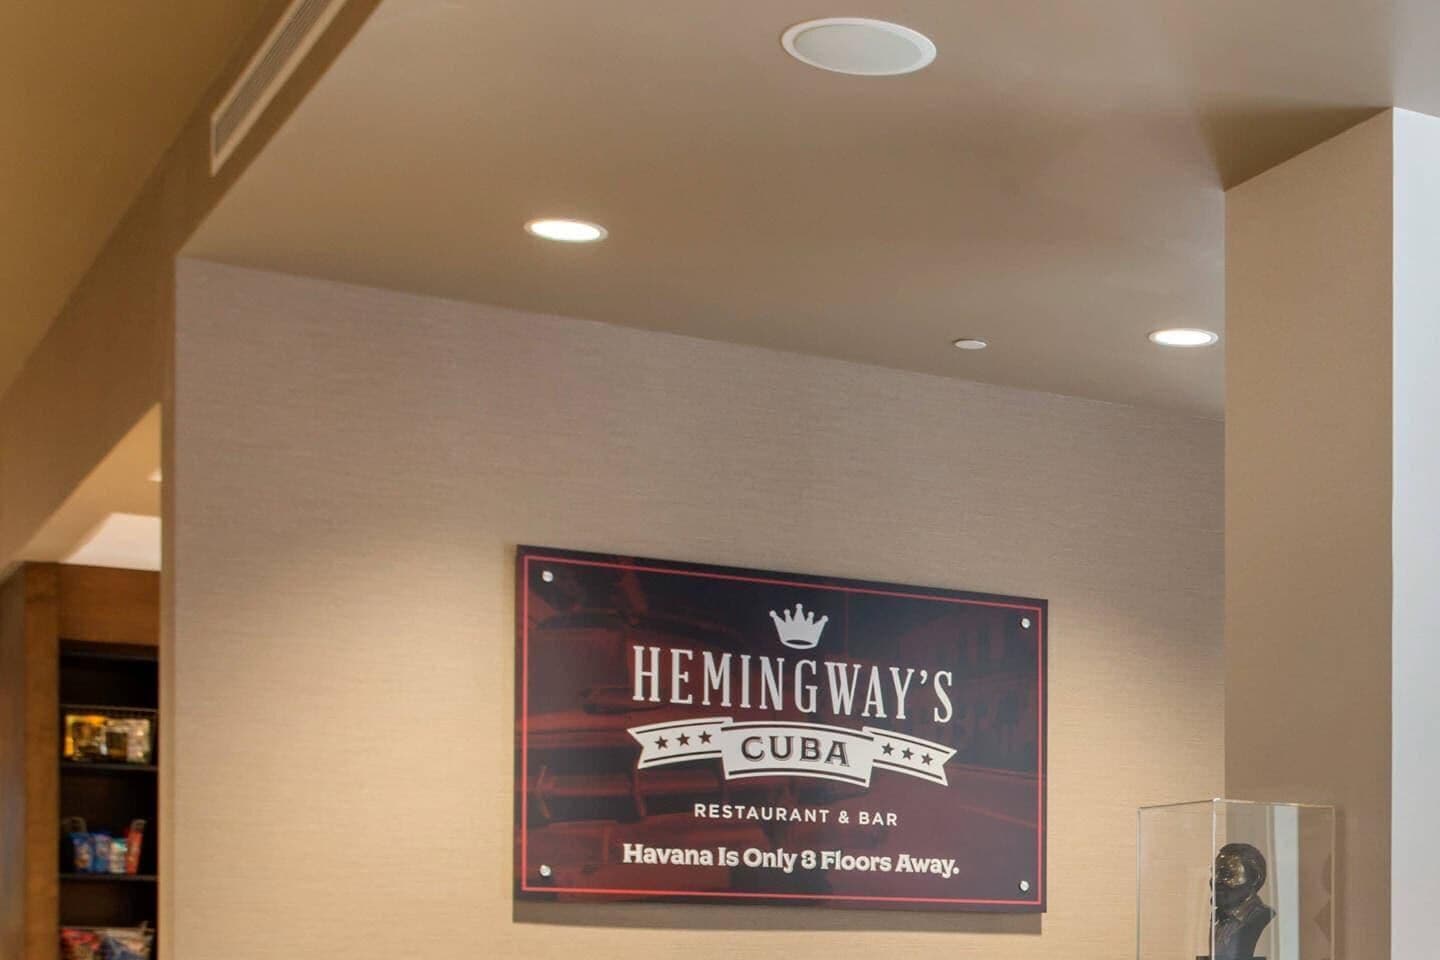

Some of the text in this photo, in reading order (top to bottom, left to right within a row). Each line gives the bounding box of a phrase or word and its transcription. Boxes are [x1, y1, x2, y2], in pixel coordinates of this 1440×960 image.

[632, 645, 953, 723] HEMINGWAY'S
[741, 735, 850, 767] CUBA
[694, 803, 898, 826] RESTAURANT & BAR
[622, 843, 714, 866] Havana
[717, 847, 739, 867] Is
[743, 847, 798, 874] Only
[820, 851, 892, 873] Floors
[895, 854, 960, 878] Away.
